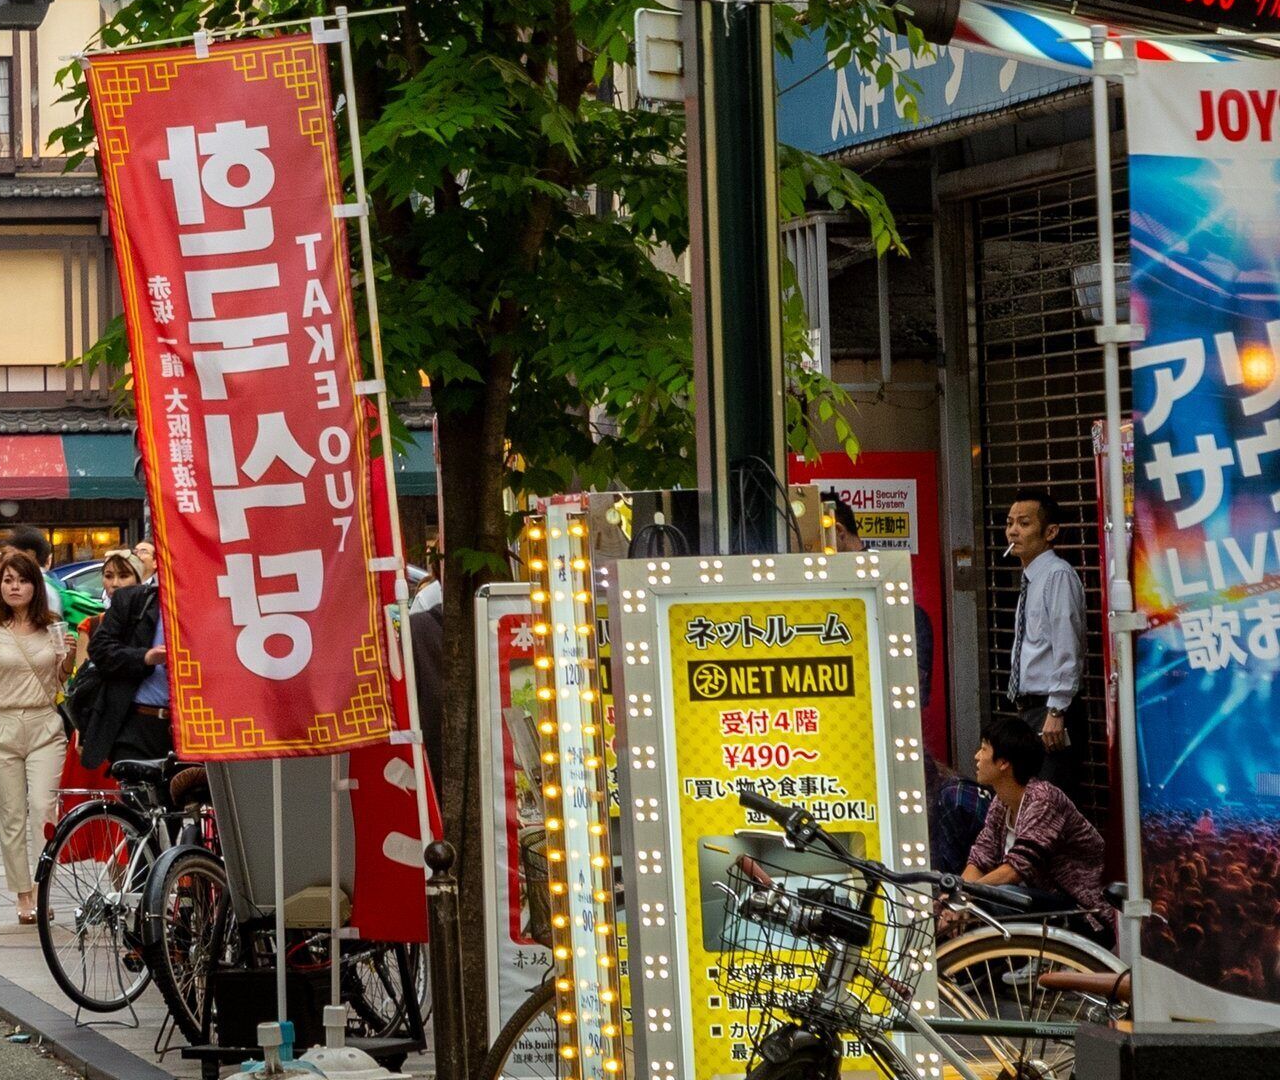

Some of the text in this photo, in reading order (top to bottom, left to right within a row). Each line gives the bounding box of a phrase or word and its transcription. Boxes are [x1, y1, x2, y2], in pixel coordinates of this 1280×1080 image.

[1196, 88, 1280, 143] JOY
[840, 489, 909, 510] 24H Security System
[685, 613, 853, 650] ネットルーム
[729, 663, 849, 696] NET MARU
[721, 708, 819, 736] 受付4階
